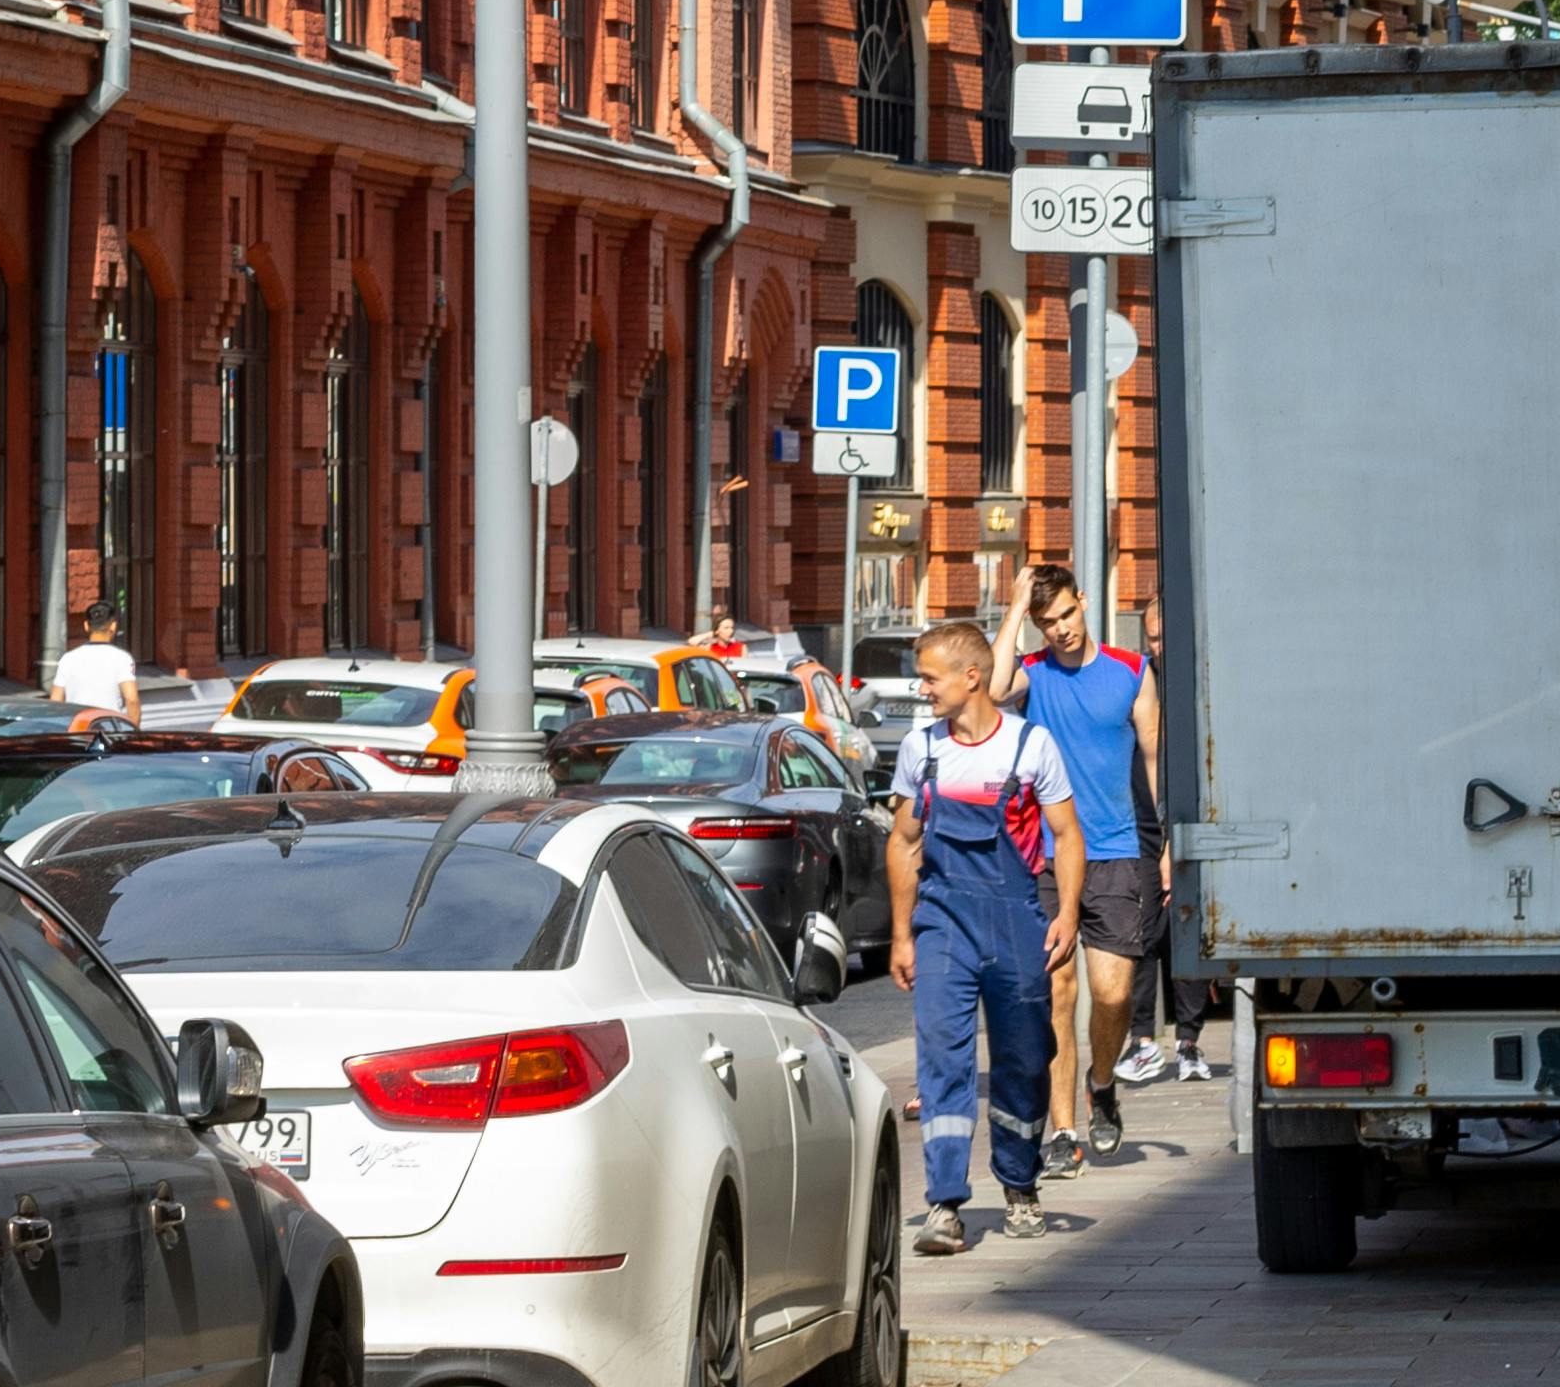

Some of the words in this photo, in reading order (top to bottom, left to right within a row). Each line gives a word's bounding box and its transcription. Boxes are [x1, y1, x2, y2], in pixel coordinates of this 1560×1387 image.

[1032, 199, 1056, 220] 10
[1067, 197, 1097, 224] 15
[837, 358, 883, 421] P
